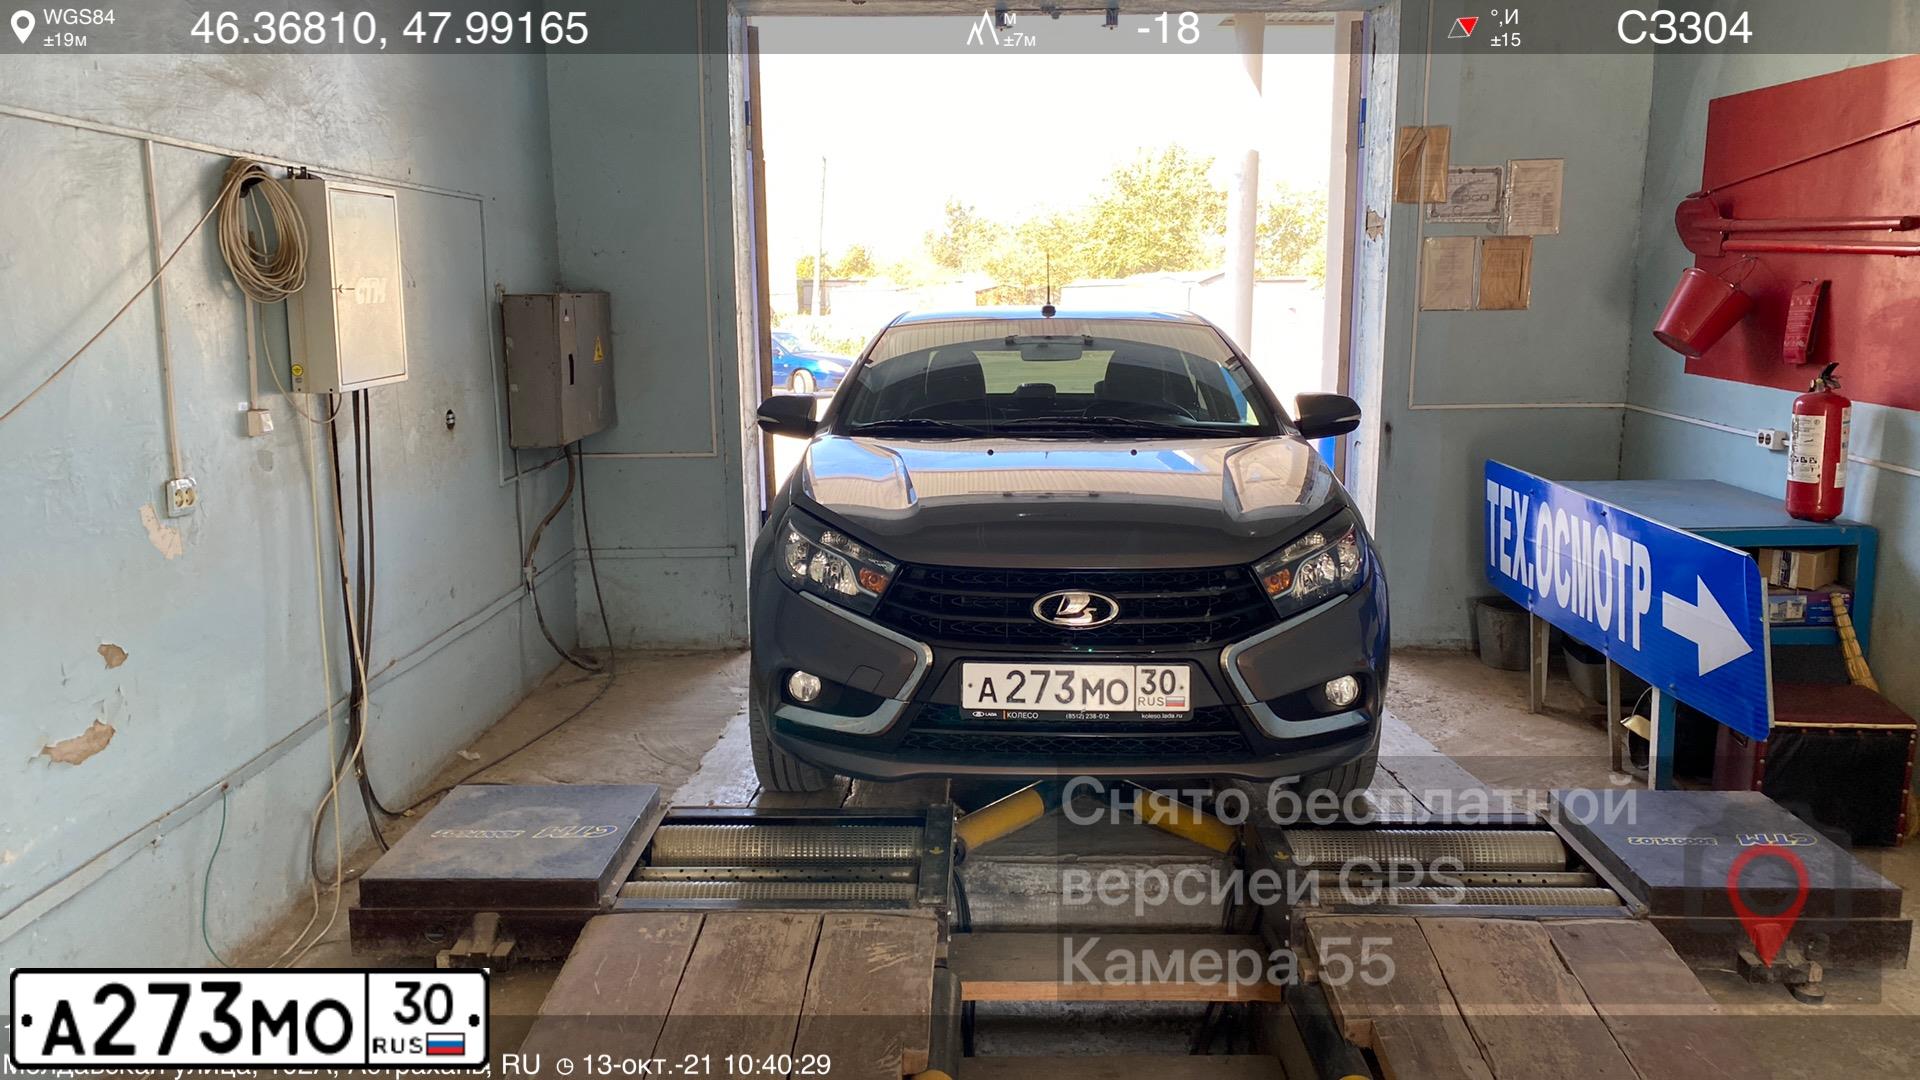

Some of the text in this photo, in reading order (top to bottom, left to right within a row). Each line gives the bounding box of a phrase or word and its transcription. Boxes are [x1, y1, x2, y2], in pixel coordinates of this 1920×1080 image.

[1486, 478, 1653, 651] ТЕХ.ОСМОТР
[977, 668, 1177, 705] А273МО 30
[1137, 696, 1165, 707] RUS
[1007, 711, 1039, 719] КОЛЕСО
